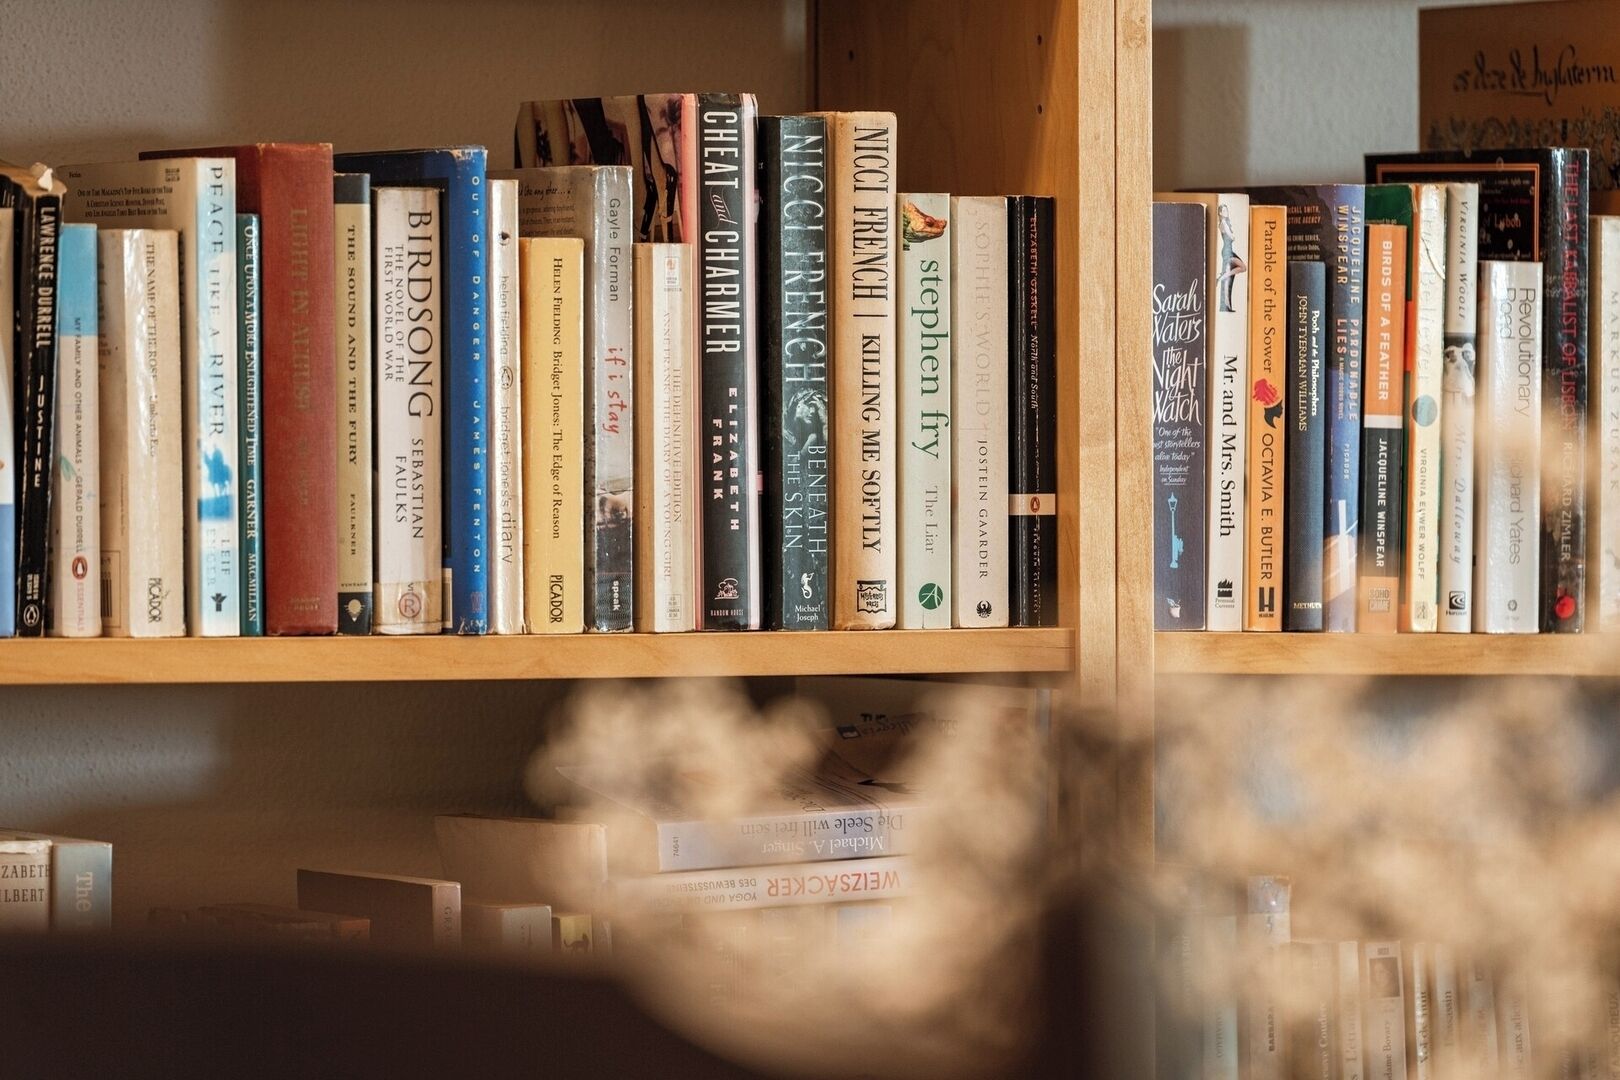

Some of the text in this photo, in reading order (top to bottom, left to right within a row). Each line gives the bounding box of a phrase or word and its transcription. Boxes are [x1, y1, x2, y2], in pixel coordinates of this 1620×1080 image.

[851, 126, 890, 301] NICCI FRENCH
[1564, 161, 1580, 197] THE
[606, 198, 621, 303] Gayle Forman
[704, 110, 741, 354] CHEAT and CHARMER
[783, 133, 827, 384] NICCI FRENCH
[1336, 204, 1349, 285] WINSPEAR
[1349, 205, 1362, 305] JACQUELINE
[1459, 200, 1470, 265] VIRGINIA
[1563, 204, 1580, 244] LAST
[36, 206, 56, 350] LAWRENCE DURRELL
[472, 176, 482, 362] OUT OF DANGER
[1030, 217, 1038, 326] ELIZABETH GASKELL
[1152, 278, 1201, 315] Sarah
[1263, 220, 1277, 374] Parable of the Sower
[1381, 240, 1394, 287] BIRDS
[207, 166, 224, 438] PEACE LIKE A RIVER
[384, 246, 395, 382] FIRST WORLD WAR
[394, 244, 405, 383] THE NOVEL OF THE
[406, 209, 435, 419] BIRDSONG
[1380, 292, 1393, 313] OF
[1380, 316, 1391, 329] A
[347, 224, 358, 466] THE SOUND AND THE FURY
[550, 351, 564, 390] Bridget
[910, 260, 950, 460] stephen fry
[975, 332, 991, 417] WORLD
[1152, 350, 1204, 401] Night
[1298, 295, 1309, 432] JOHN TYERMAN WILLIAMS
[1308, 309, 1320, 418] Pooh Philosophers
[1336, 318, 1361, 421] PARDONABLE LIES
[1378, 332, 1391, 402] FEATHER
[1514, 287, 1536, 417] Revolutionary
[1561, 343, 1577, 367] OF
[74, 334, 83, 465] FAMILY AND OTHER ANIMALS
[550, 392, 564, 427] Jones:
[602, 347, 628, 435] if stay
[33, 374, 46, 488] JUSTINE
[552, 429, 564, 451] The
[712, 387, 741, 532] ELIZABETH FRANK
[861, 333, 882, 555] KILLING ME SOFTLY
[1219, 354, 1238, 538] Mr. and Mrs. Smith
[395, 455, 407, 524] FAULKS
[411, 438, 425, 540] SEBASTIAN
[472, 400, 482, 574] JAMES FENTON
[549, 454, 563, 480] Edge
[552, 484, 563, 497] of
[786, 450, 801, 485] THE
[807, 444, 828, 555] BENEATH
[75, 476, 84, 554] GERALD DURRELL
[551, 499, 564, 540] Reason
[924, 486, 939, 555] The Liar
[977, 439, 989, 580] JOSTEIN GAARDER
[1260, 433, 1274, 581] OCTAVIA E. BUTLER
[1375, 437, 1389, 568] JACQUELINE WINSPEAR
[1417, 447, 1428, 581] VIRGINIA WOLFF
[1561, 510, 1572, 561] ZIMLER
[220, 539, 230, 577] LEIF
[246, 479, 257, 621] GARNER MACMILLAN
[500, 512, 517, 564] diary
[1508, 517, 1524, 565] Yates
[148, 578, 163, 623] PICADOR
[549, 574, 563, 624] PICADOR
[611, 580, 620, 612] speak
[794, 603, 822, 613] Michael
[796, 614, 819, 622] Joseph
[802, 818, 833, 838] will
[807, 839, 827, 854] A.
[830, 834, 885, 856] Michael
[834, 815, 874, 834] Seele
[0, 888, 45, 903] LBERT
[1, 864, 49, 879] ZABET
[76, 871, 93, 912] The
[728, 892, 758, 904] YOGA
[738, 878, 757, 889] DES
[767, 869, 900, 899] WEIZSÄCKER
